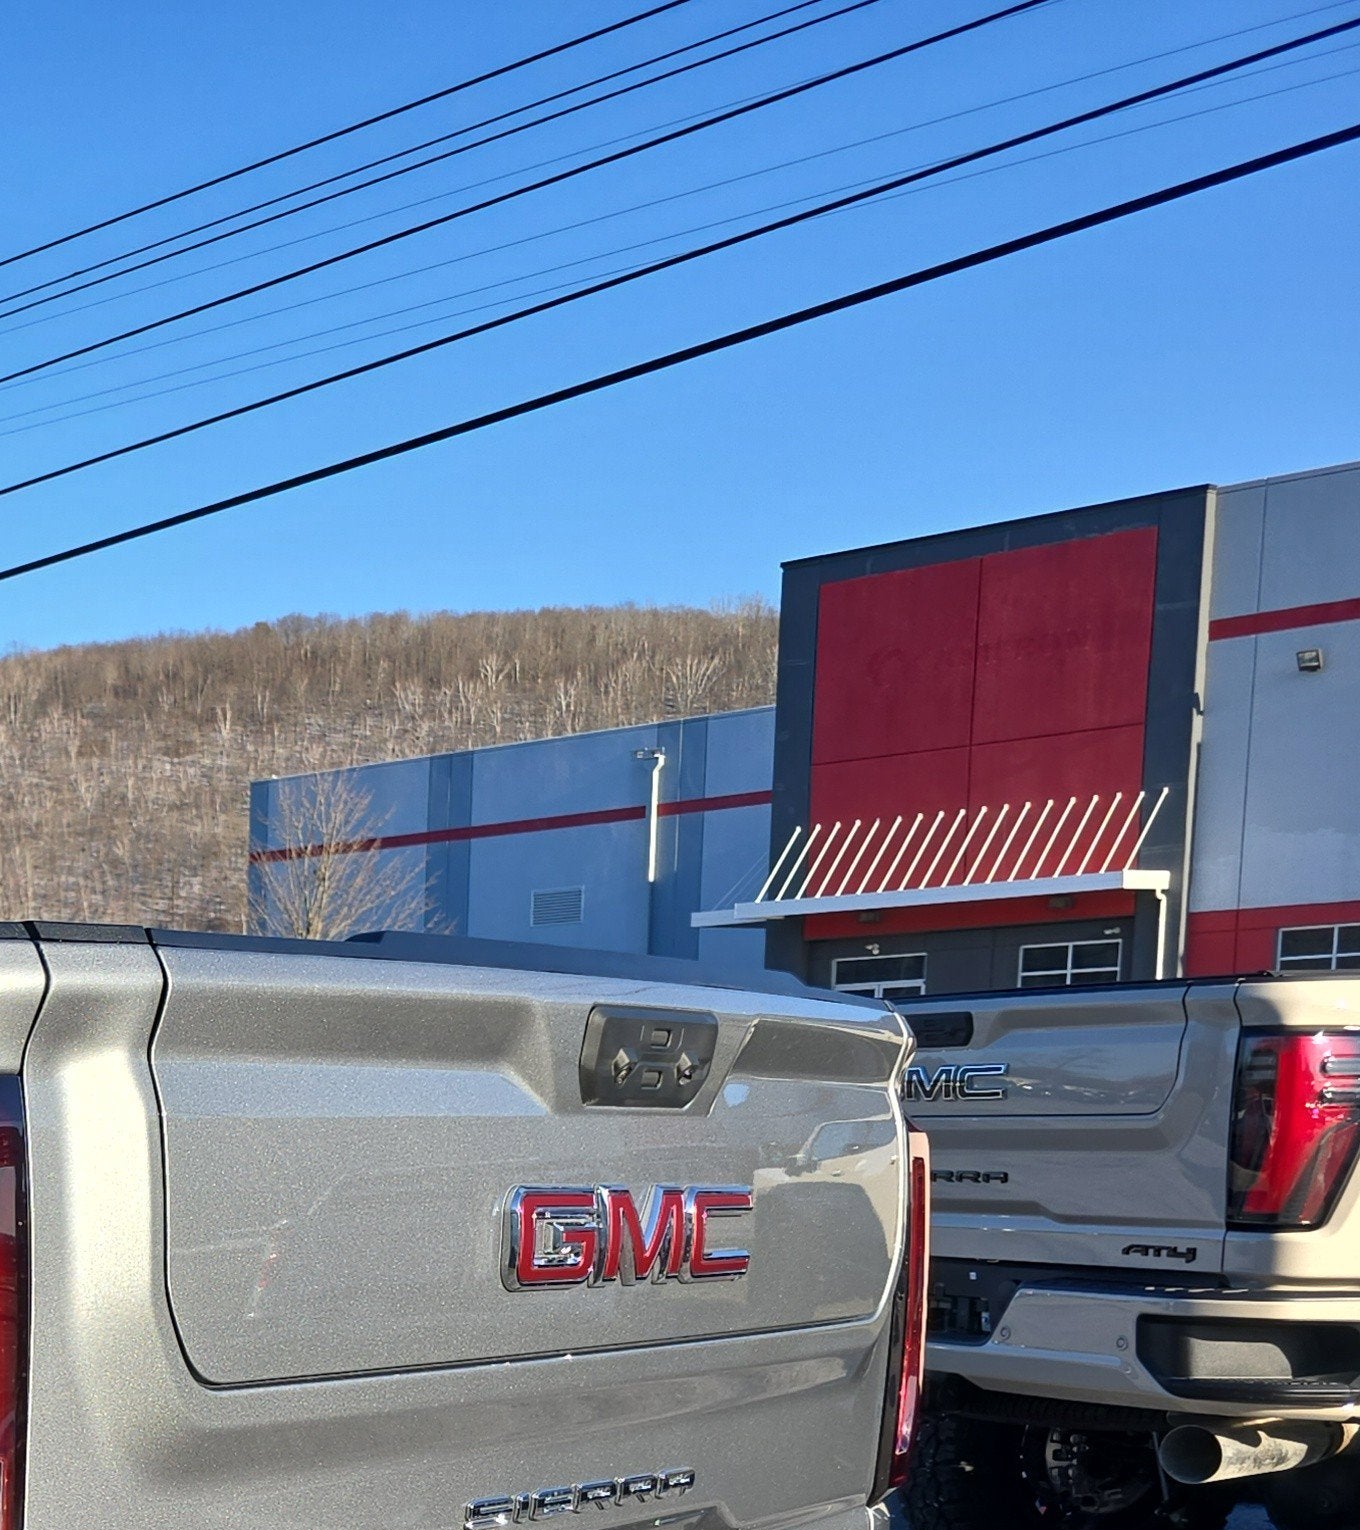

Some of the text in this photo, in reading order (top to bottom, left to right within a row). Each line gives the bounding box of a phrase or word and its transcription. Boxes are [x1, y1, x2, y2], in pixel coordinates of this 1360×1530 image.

[899, 1063, 1008, 1101] MC
[931, 1169, 1009, 1183] RRA
[500, 1183, 754, 1292] GMC
[1121, 1244, 1197, 1264] AT4
[464, 1466, 696, 1530] SIERRA
